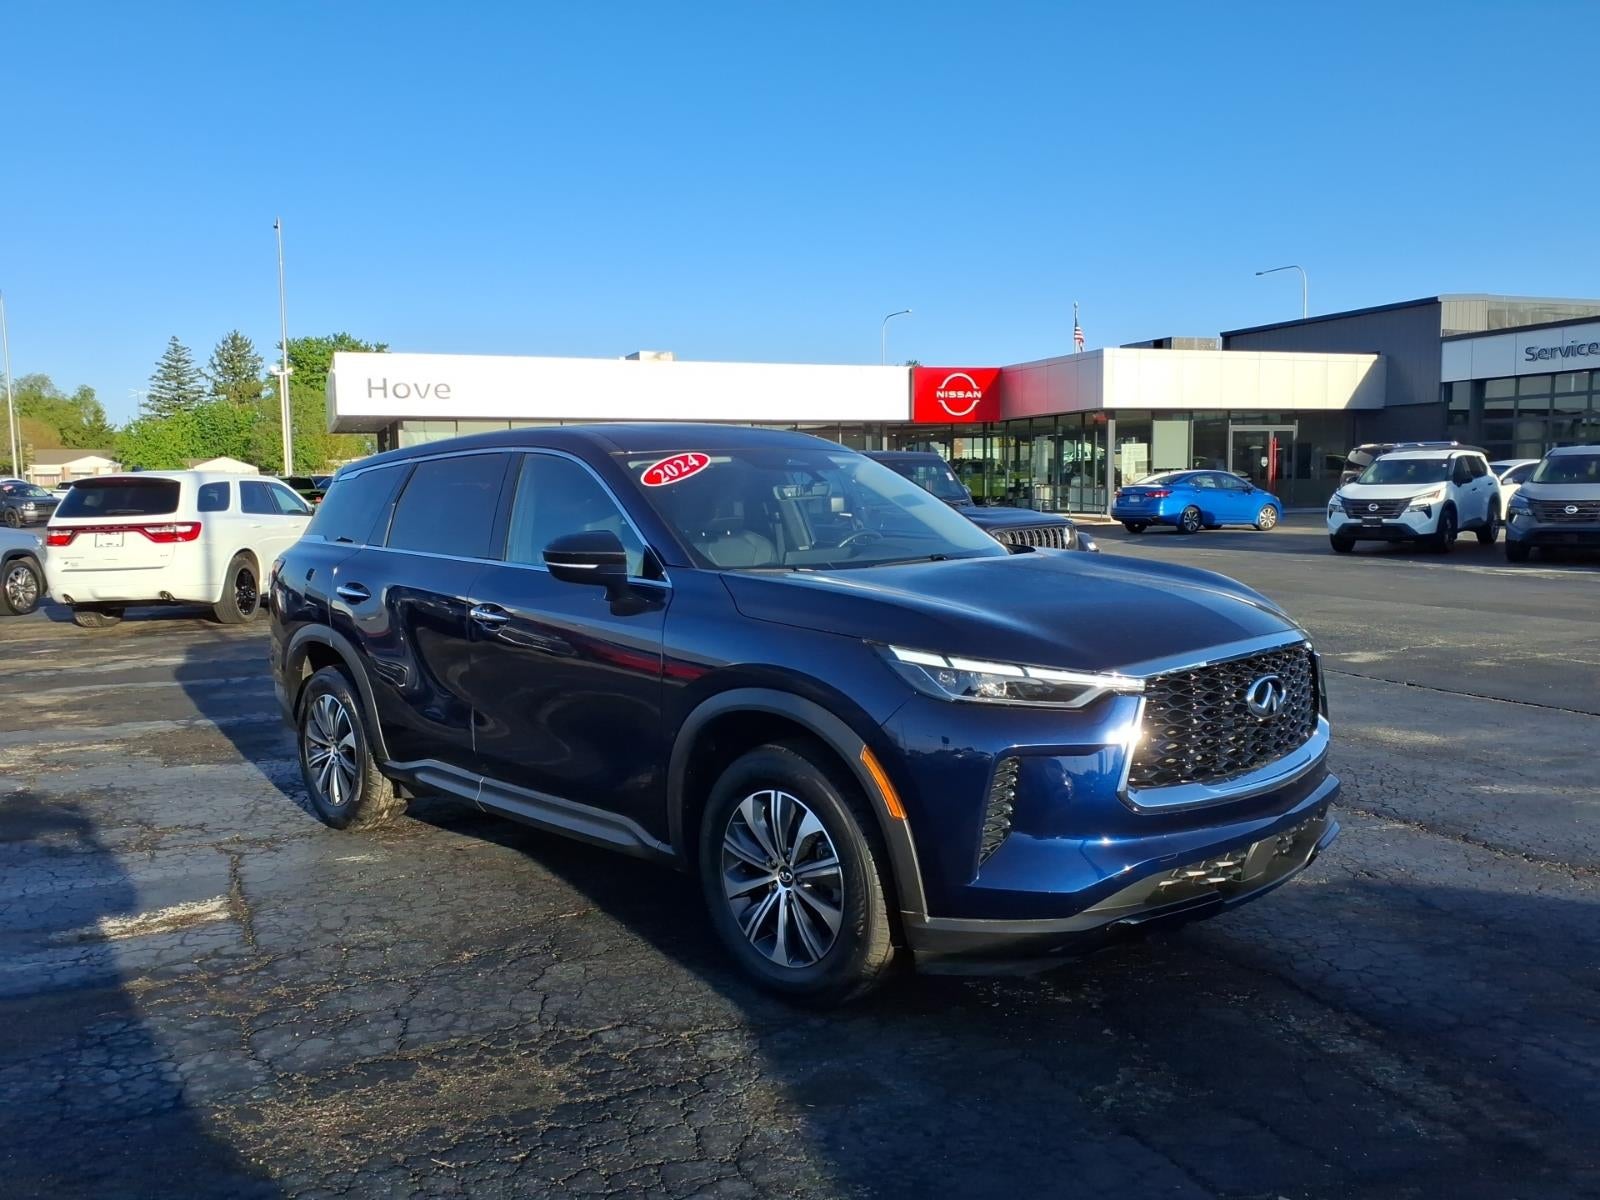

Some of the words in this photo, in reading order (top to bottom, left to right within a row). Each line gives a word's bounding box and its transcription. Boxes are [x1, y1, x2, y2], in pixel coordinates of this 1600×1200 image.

[1525, 340, 1599, 361] Service
[367, 377, 451, 400] Hove
[936, 390, 982, 399] NISSAN
[652, 454, 700, 483] 2024
